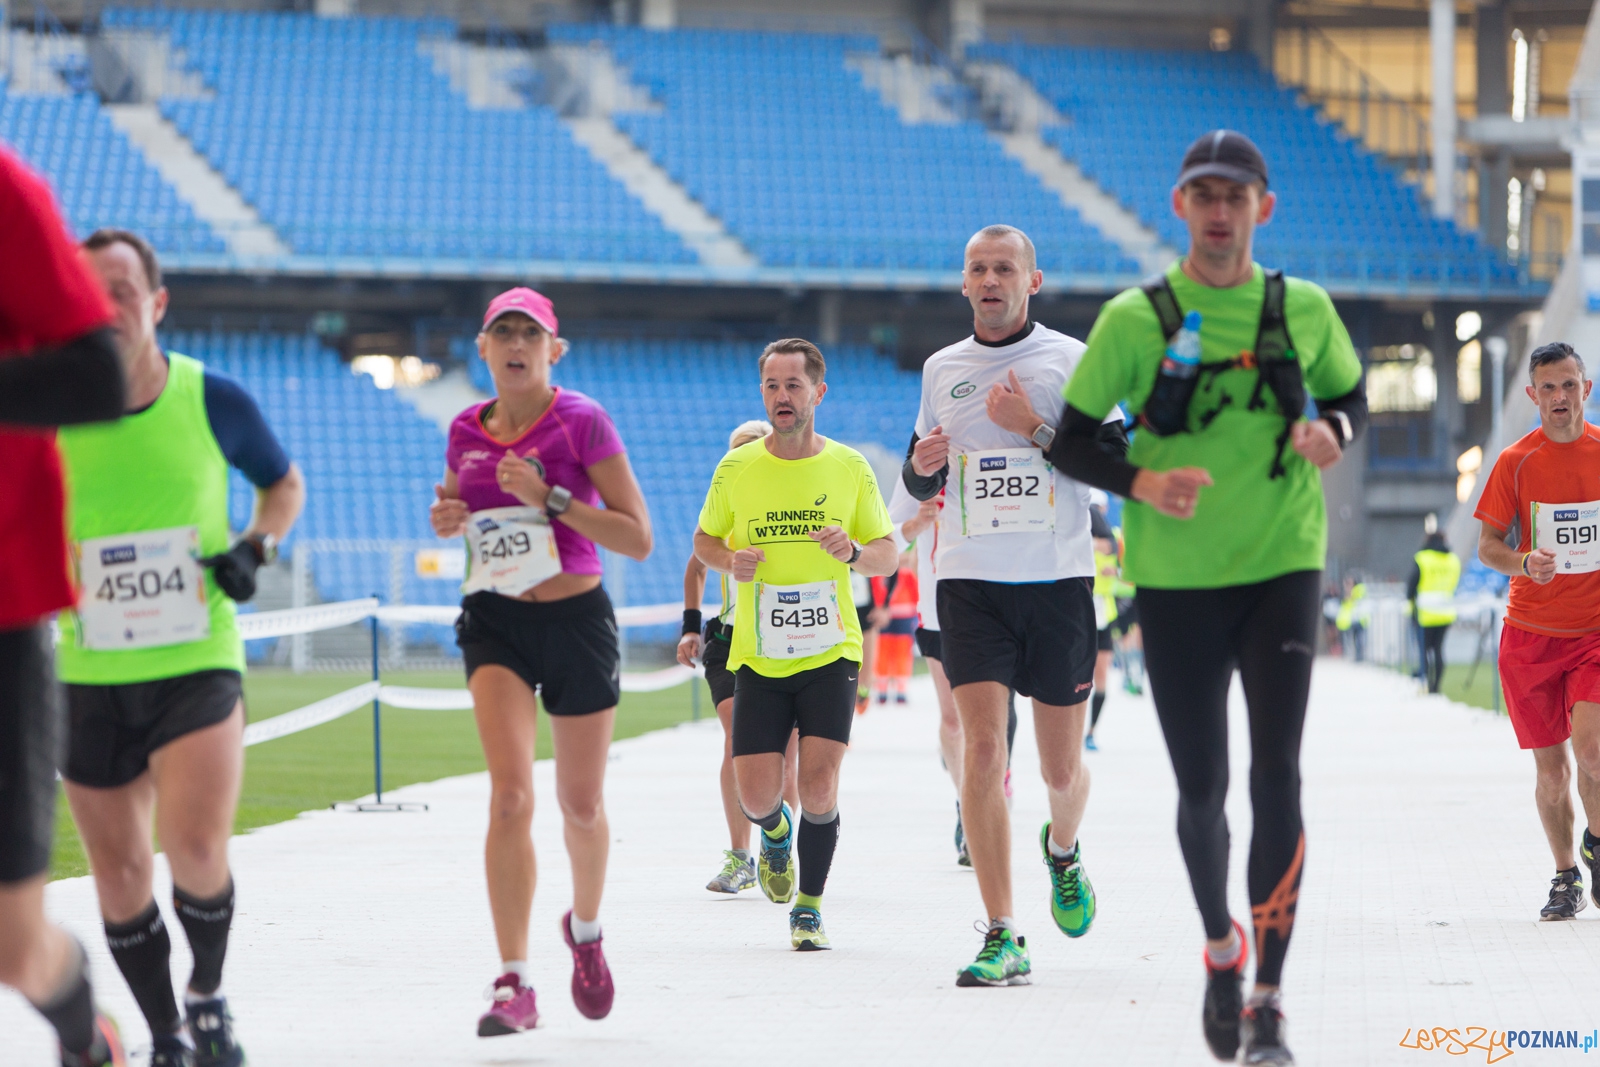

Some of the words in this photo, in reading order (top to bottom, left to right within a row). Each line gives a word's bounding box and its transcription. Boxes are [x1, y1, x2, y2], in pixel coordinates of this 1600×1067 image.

[956, 387, 970, 395] SGB
[975, 476, 1039, 499] 3282
[766, 510, 825, 522] RUNNER'S
[755, 524, 825, 538] WYZWAN
[1556, 525, 1597, 544] 6191
[95, 565, 185, 603] 4504
[771, 607, 829, 627] 6438
